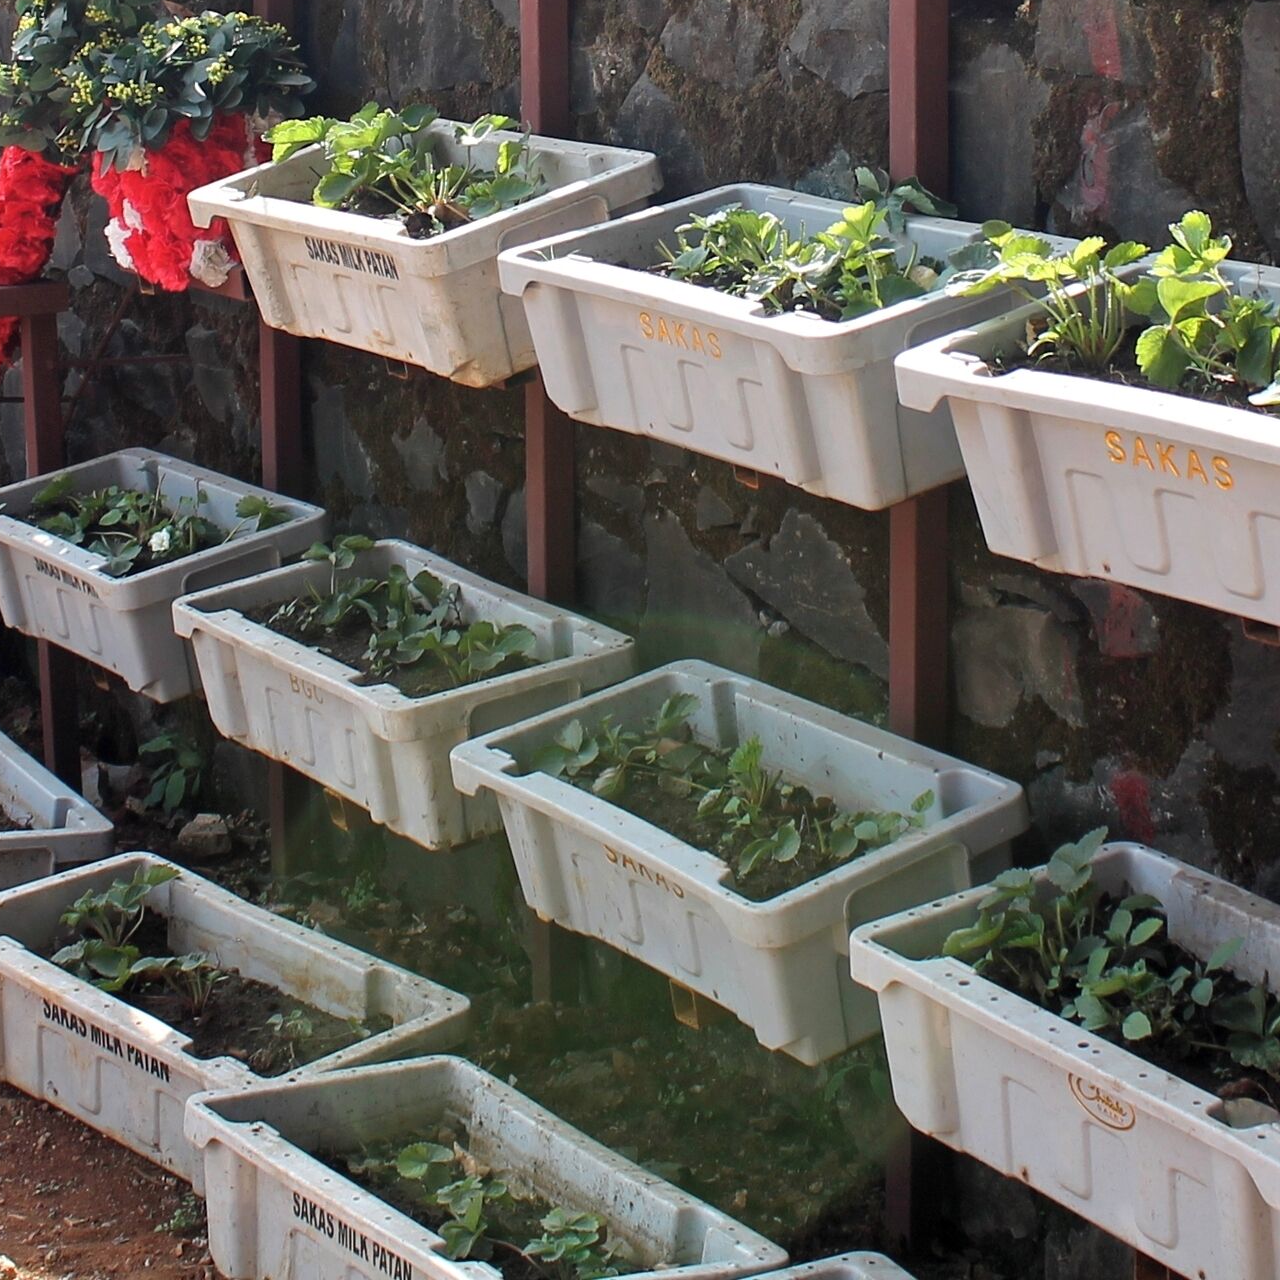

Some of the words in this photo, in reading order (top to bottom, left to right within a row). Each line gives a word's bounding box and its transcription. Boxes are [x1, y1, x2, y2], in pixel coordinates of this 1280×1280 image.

[304, 236, 340, 265] SAKAS
[339, 242, 366, 272] MILK
[363, 250, 399, 281] PATAN
[640, 312, 722, 358] SAKAS
[1105, 430, 1234, 490] SAKAS
[293, 1191, 335, 1239] SAKAS
[338, 1219, 369, 1261] MILK
[372, 1241, 412, 1280] PATAN
